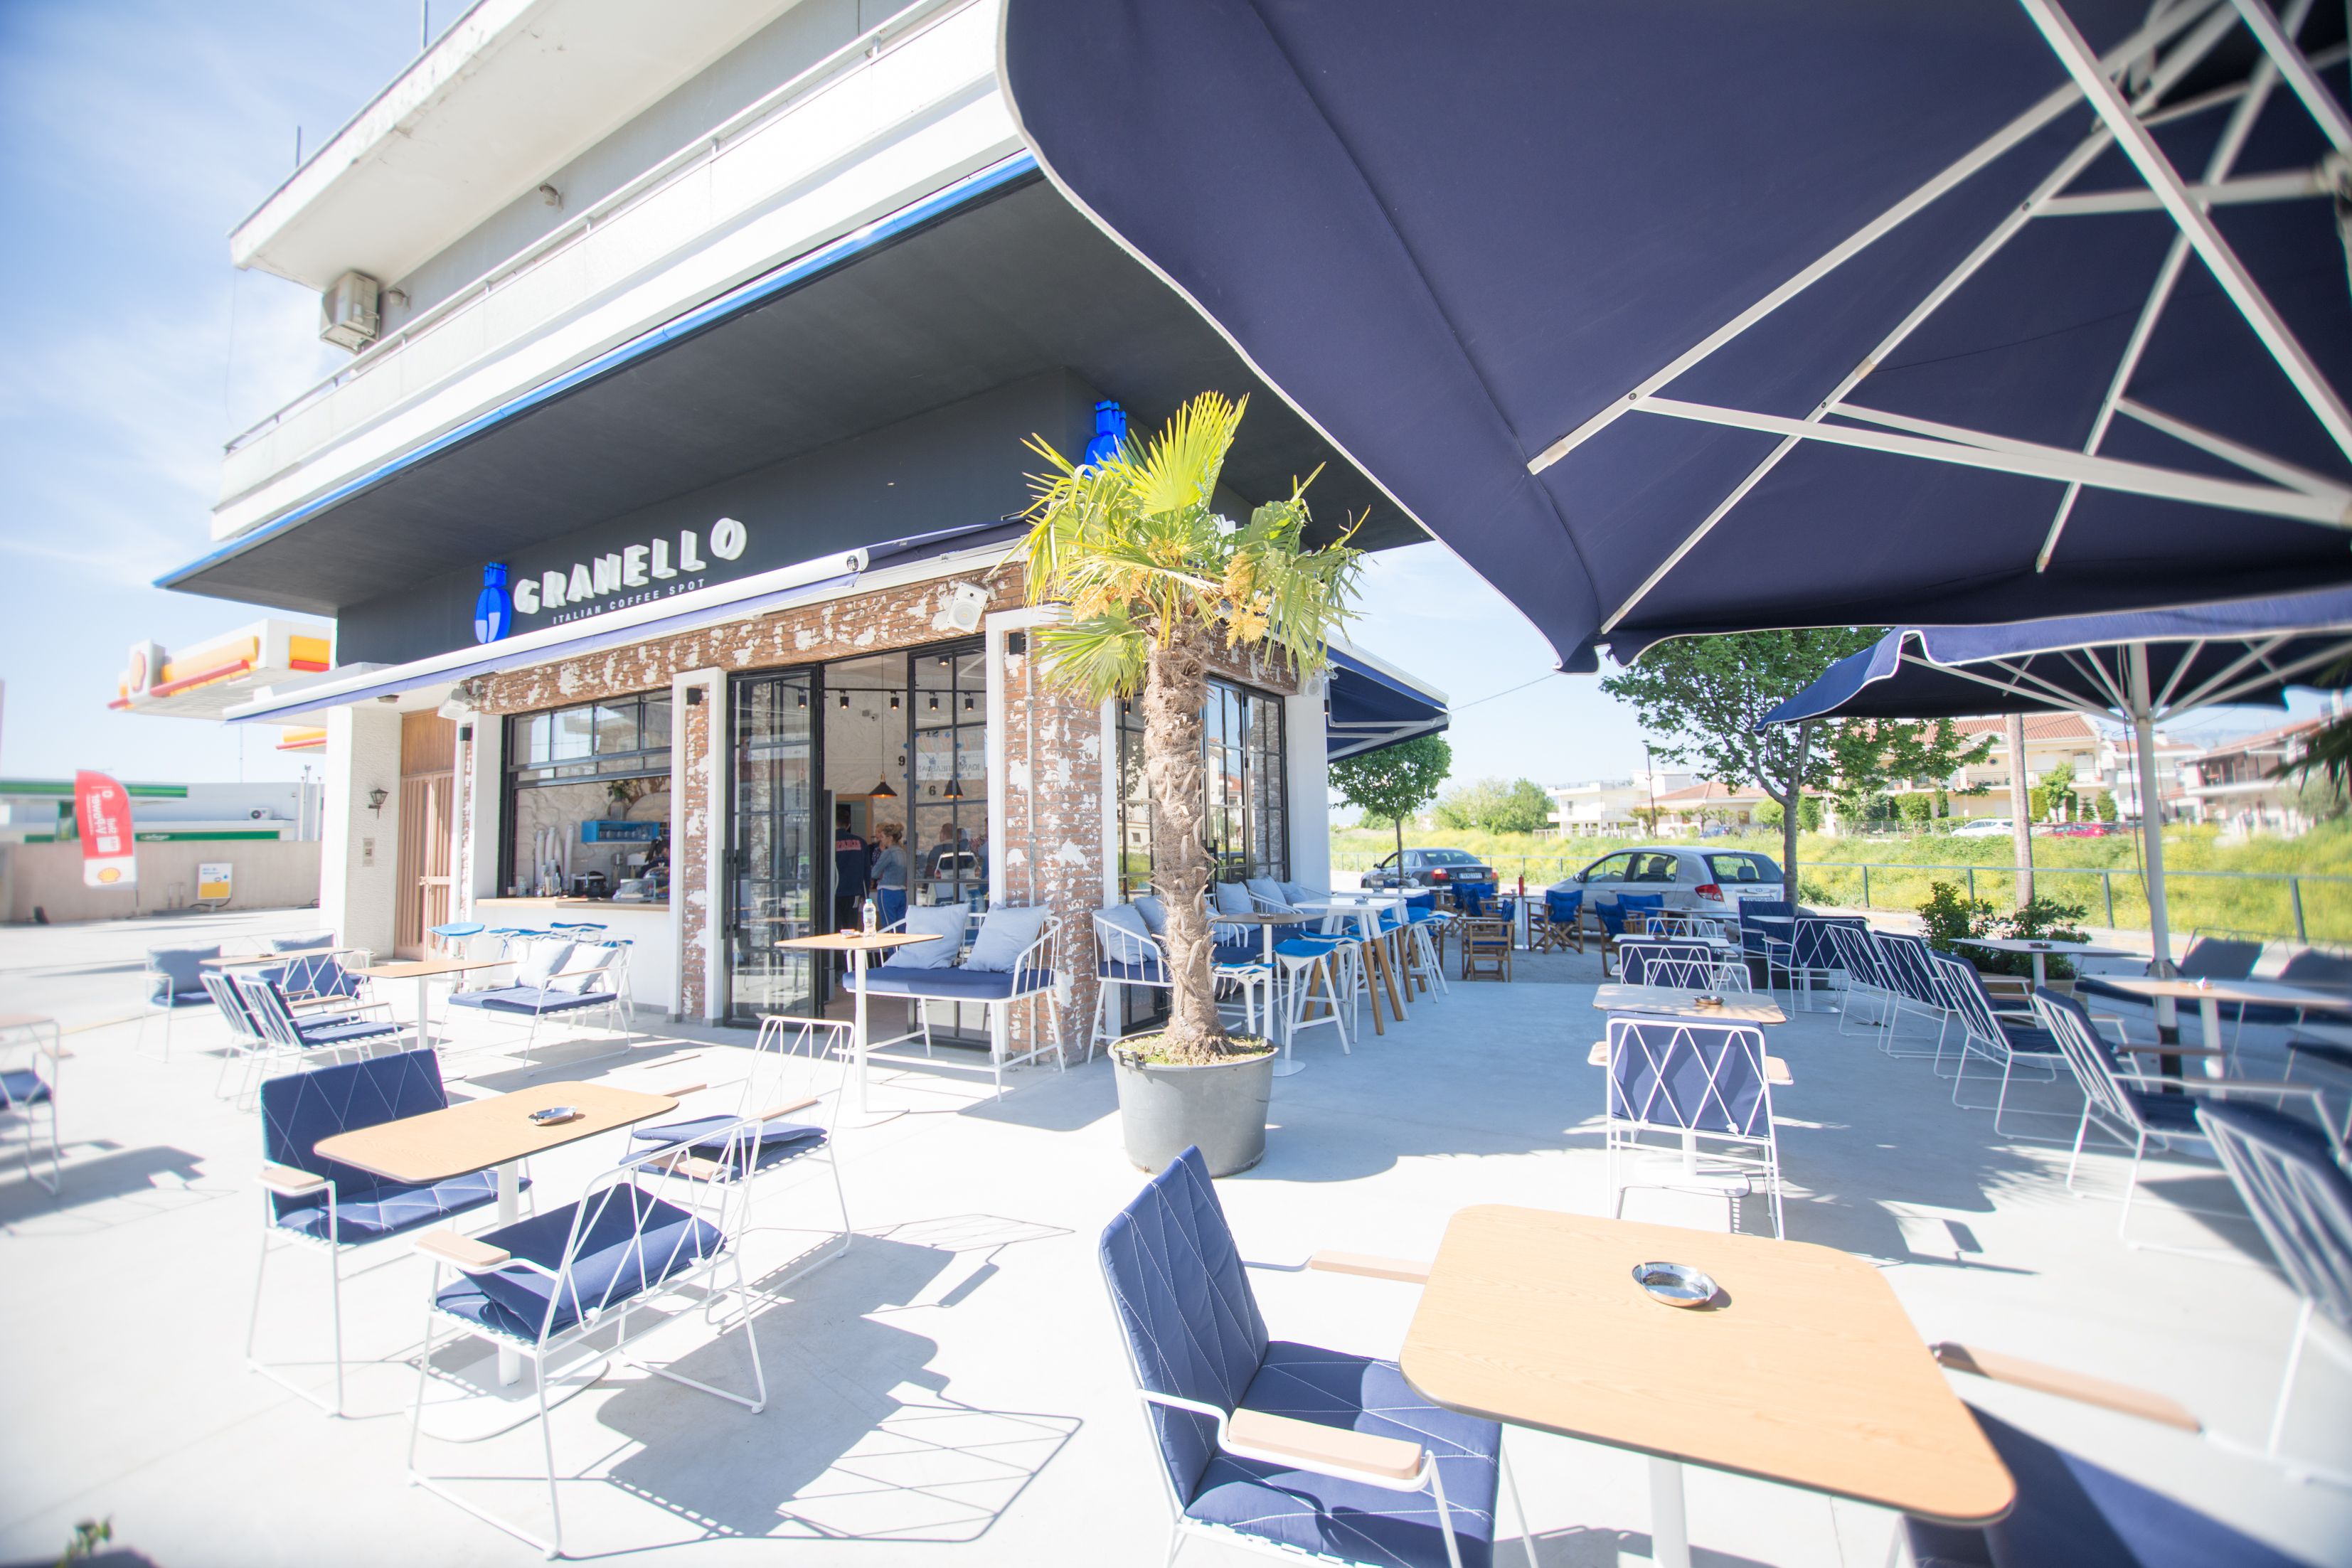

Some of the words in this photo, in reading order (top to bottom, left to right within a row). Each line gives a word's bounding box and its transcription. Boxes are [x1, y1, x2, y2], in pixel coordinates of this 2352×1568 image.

[513, 517, 747, 614] GRANELLO
[553, 605, 602, 625] ITALIAN
[610, 590, 660, 611] COFFEE
[669, 578, 706, 595] SPOT
[898, 755, 905, 766] 9
[929, 785, 936, 796] 6
